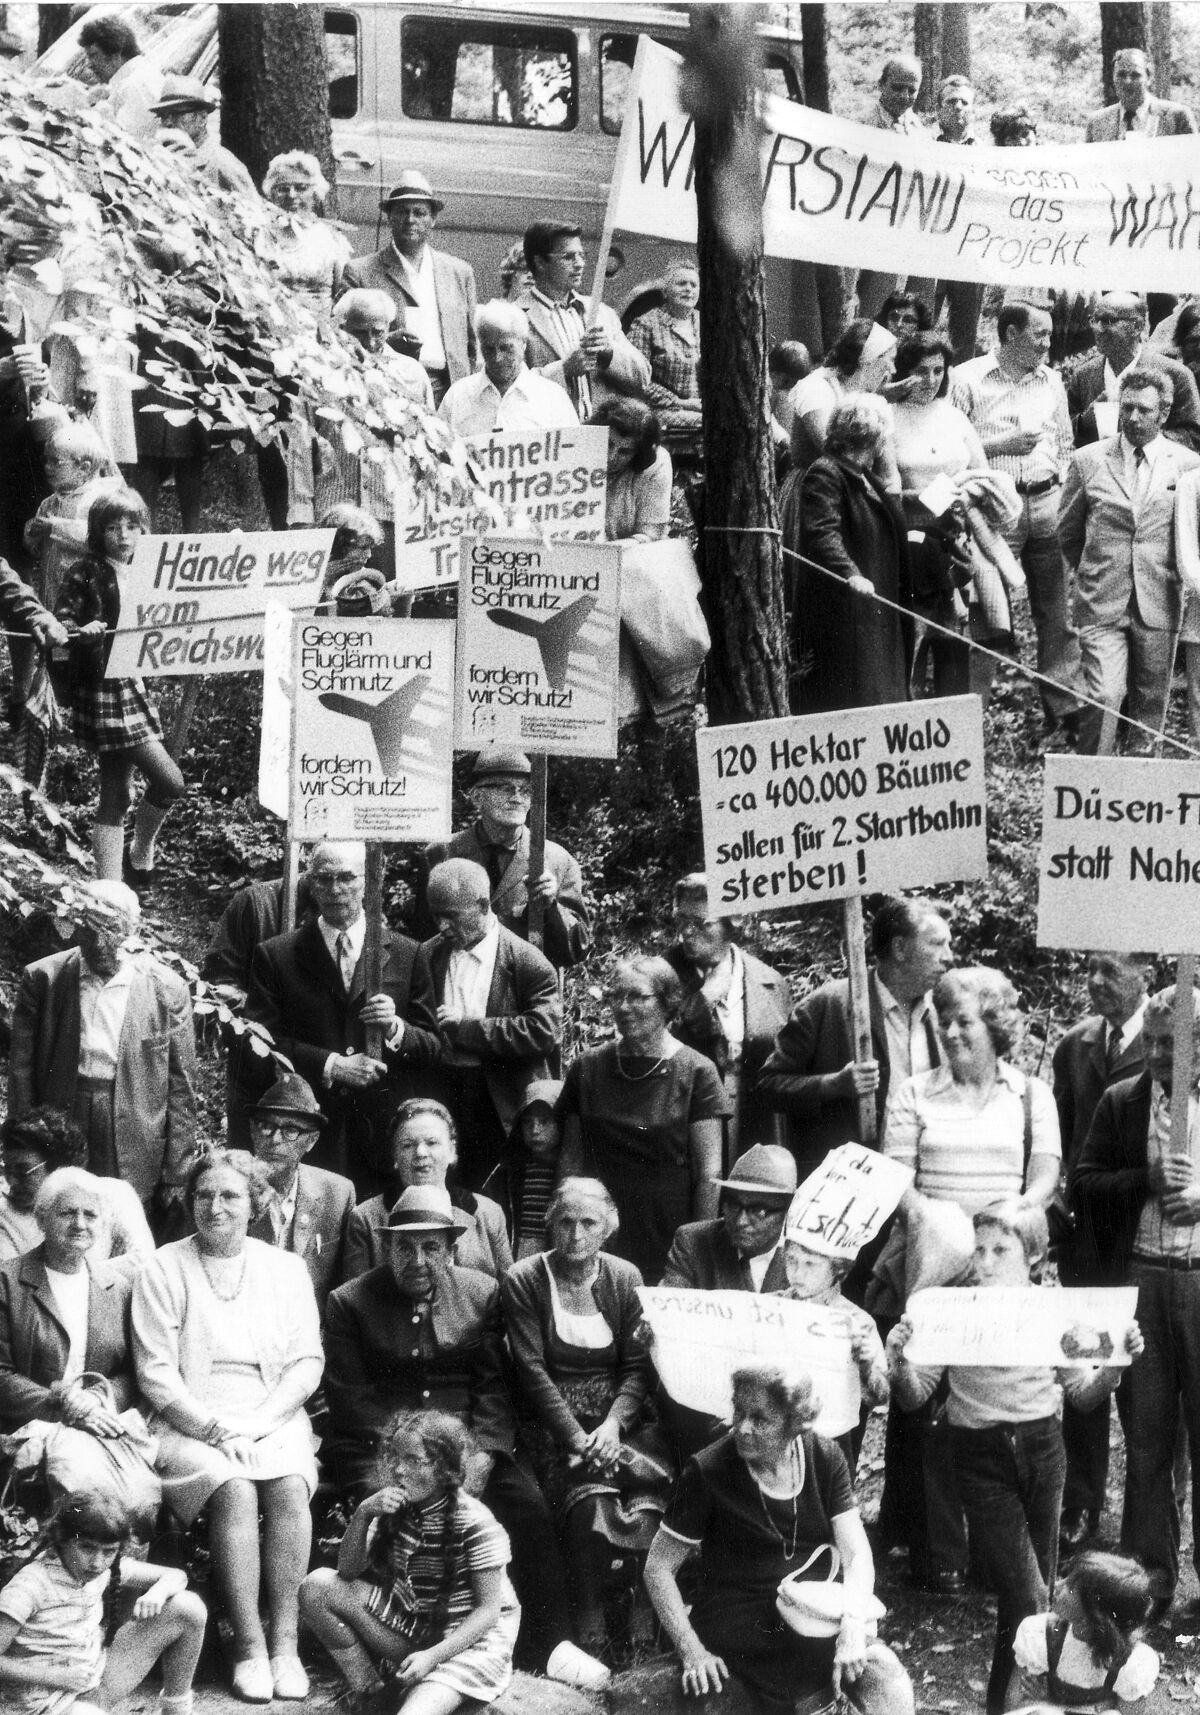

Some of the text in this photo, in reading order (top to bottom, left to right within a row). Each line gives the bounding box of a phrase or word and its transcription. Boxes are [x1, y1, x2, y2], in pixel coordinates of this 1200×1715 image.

[1009, 192, 1064, 223] das
[958, 222, 1090, 269] Projekt
[153, 541, 326, 590] Hände weg
[471, 546, 541, 569] Gegen
[471, 566, 600, 591] Fluglärm und
[471, 586, 561, 609] Schmutz
[137, 600, 200, 625] vom
[302, 626, 372, 650] Gegen
[302, 648, 432, 672] Fluglärm und
[301, 670, 393, 691] Schmutz
[469, 664, 538, 685] fordern
[468, 685, 573, 708] wir Schutz!
[712, 718, 951, 778] 120 Hektar Wald
[300, 754, 372, 774] fordern
[299, 776, 406, 796] wir Schutz!
[766, 767, 867, 808] 400.000
[876, 759, 971, 794] Bäume
[716, 829, 784, 864] sollen
[792, 822, 825, 859] für
[855, 800, 982, 843] Startbahn
[1047, 846, 1113, 880] statt
